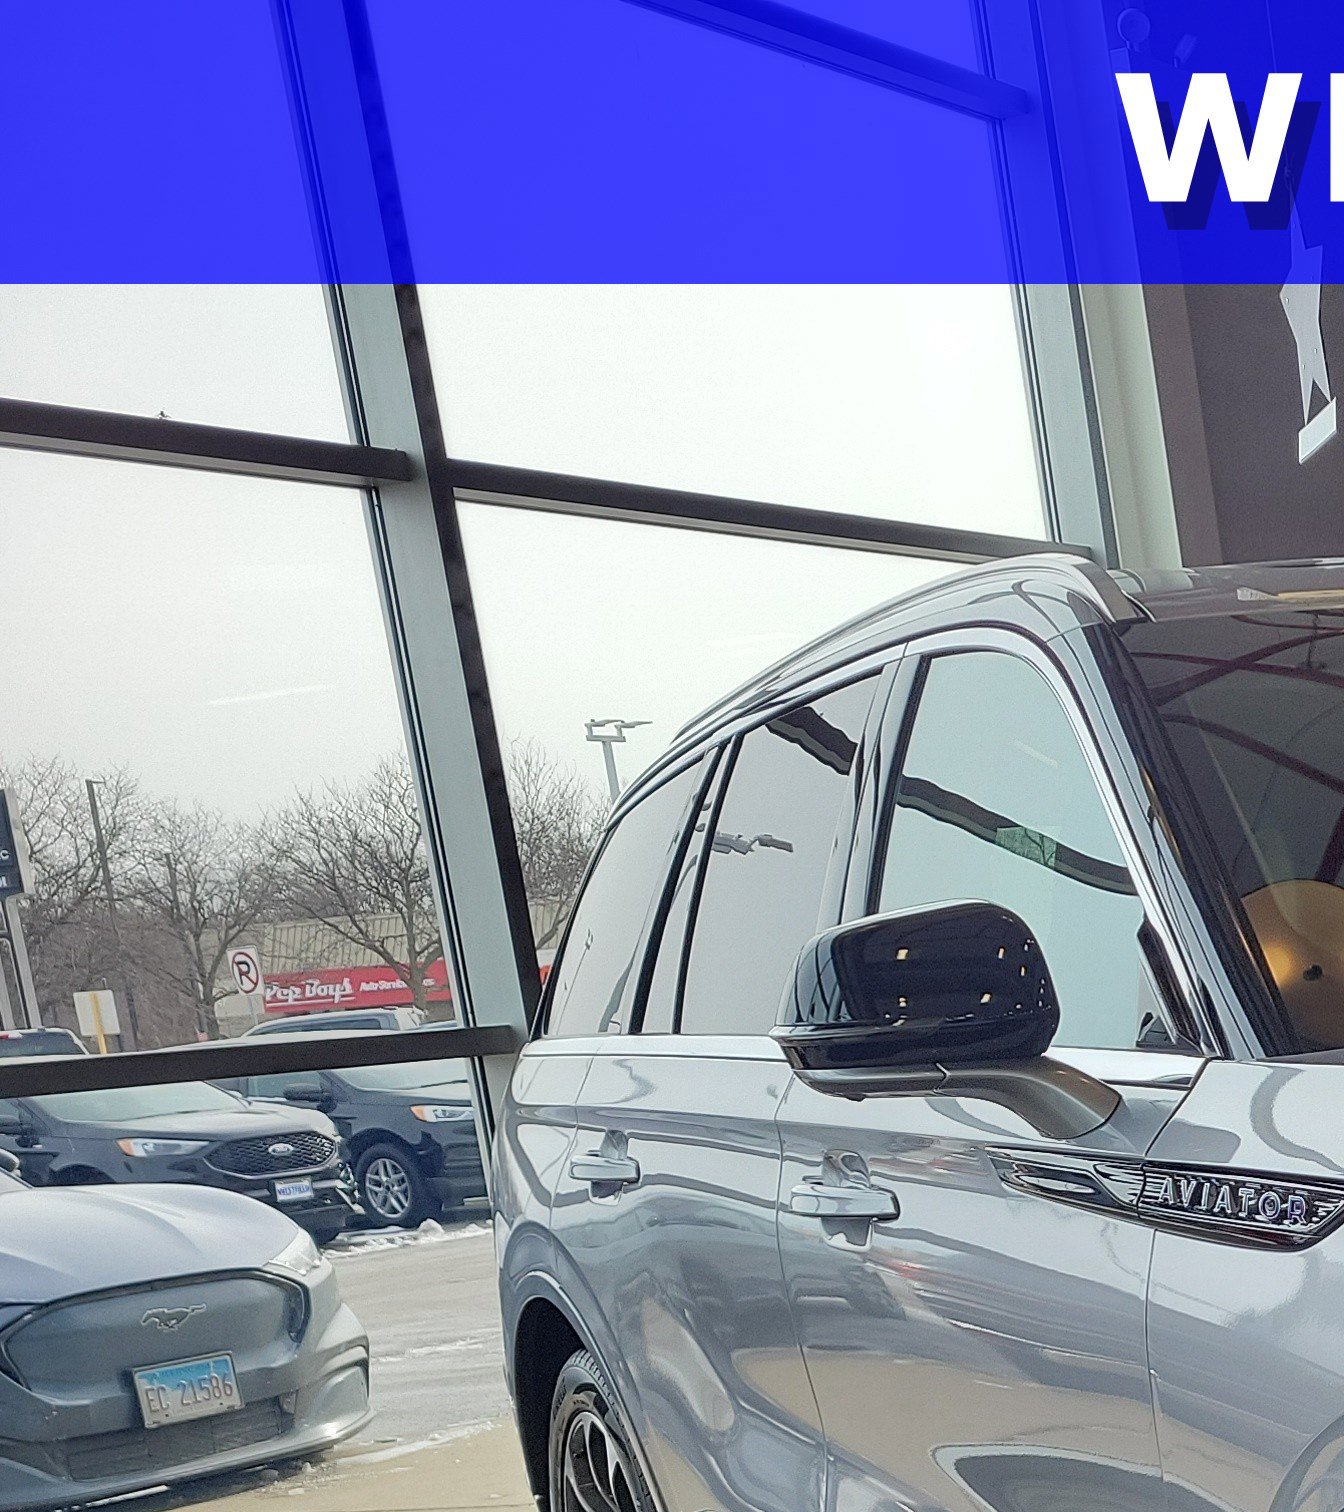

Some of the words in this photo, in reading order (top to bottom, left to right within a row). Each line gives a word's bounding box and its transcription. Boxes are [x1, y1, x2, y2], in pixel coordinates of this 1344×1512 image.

[301, 977, 353, 1004] Boys
[1158, 1177, 1308, 1225] AVIATOR
[145, 1384, 170, 1413] EC
[179, 1373, 232, 1406] 21586
